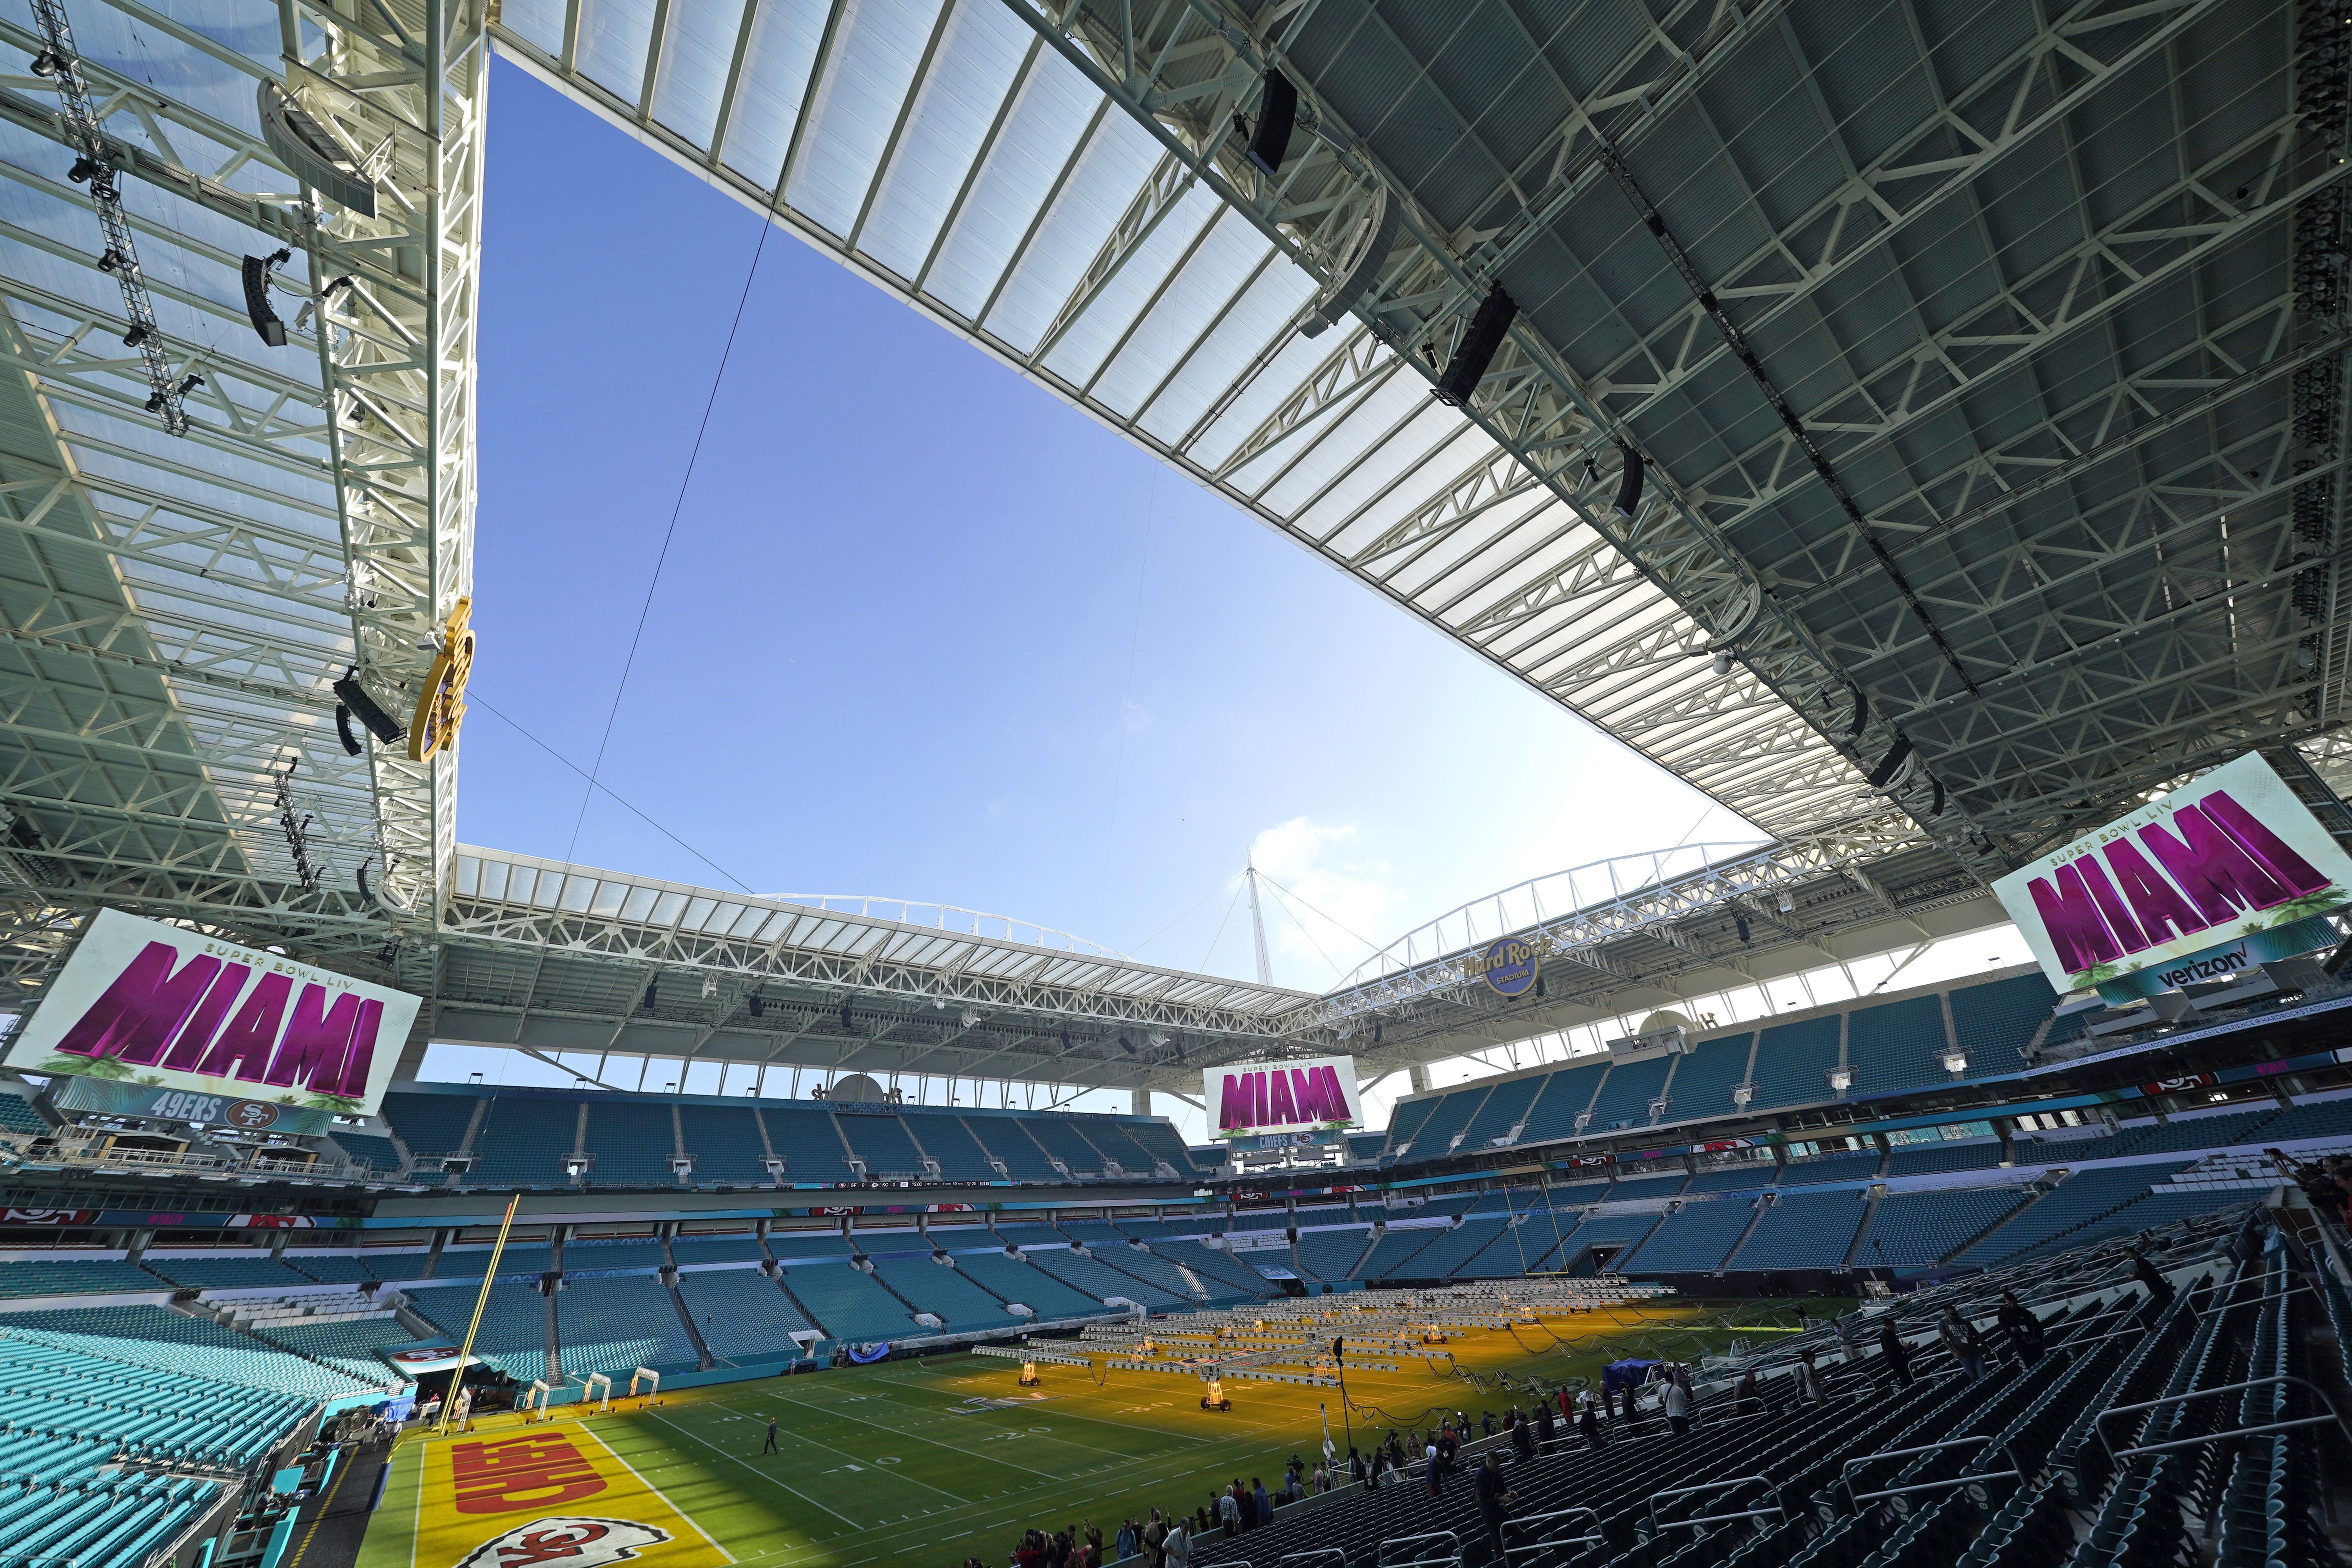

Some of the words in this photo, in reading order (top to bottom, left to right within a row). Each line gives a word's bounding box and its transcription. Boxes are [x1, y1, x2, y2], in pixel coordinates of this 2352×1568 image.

[2050, 840, 2094, 866] SUPER
[2098, 819, 2141, 842] BOWL
[2145, 800, 2172, 819] LIV
[2027, 789, 2332, 974] MIAMI
[205, 943, 264, 967] SUPER
[273, 962, 318, 982] BOWL
[327, 976, 354, 989] LIV
[1464, 946, 1506, 978] Hard
[1506, 934, 1554, 966] Rock
[2157, 952, 2247, 988] verizon
[1496, 969, 1530, 985] STADIUM
[54, 941, 384, 1098] MIAMI
[151, 1091, 222, 1122] 49ERS
[240, 1103, 269, 1126] SF
[1219, 1065, 1352, 1129] MIAMI
[1259, 1134, 1288, 1148] CHIEFS
[1125, 1402, 1174, 1412] 30
[996, 1427, 1052, 1440] 20
[451, 1432, 607, 1514] CHIEFS
[840, 1457, 901, 1472] 10
